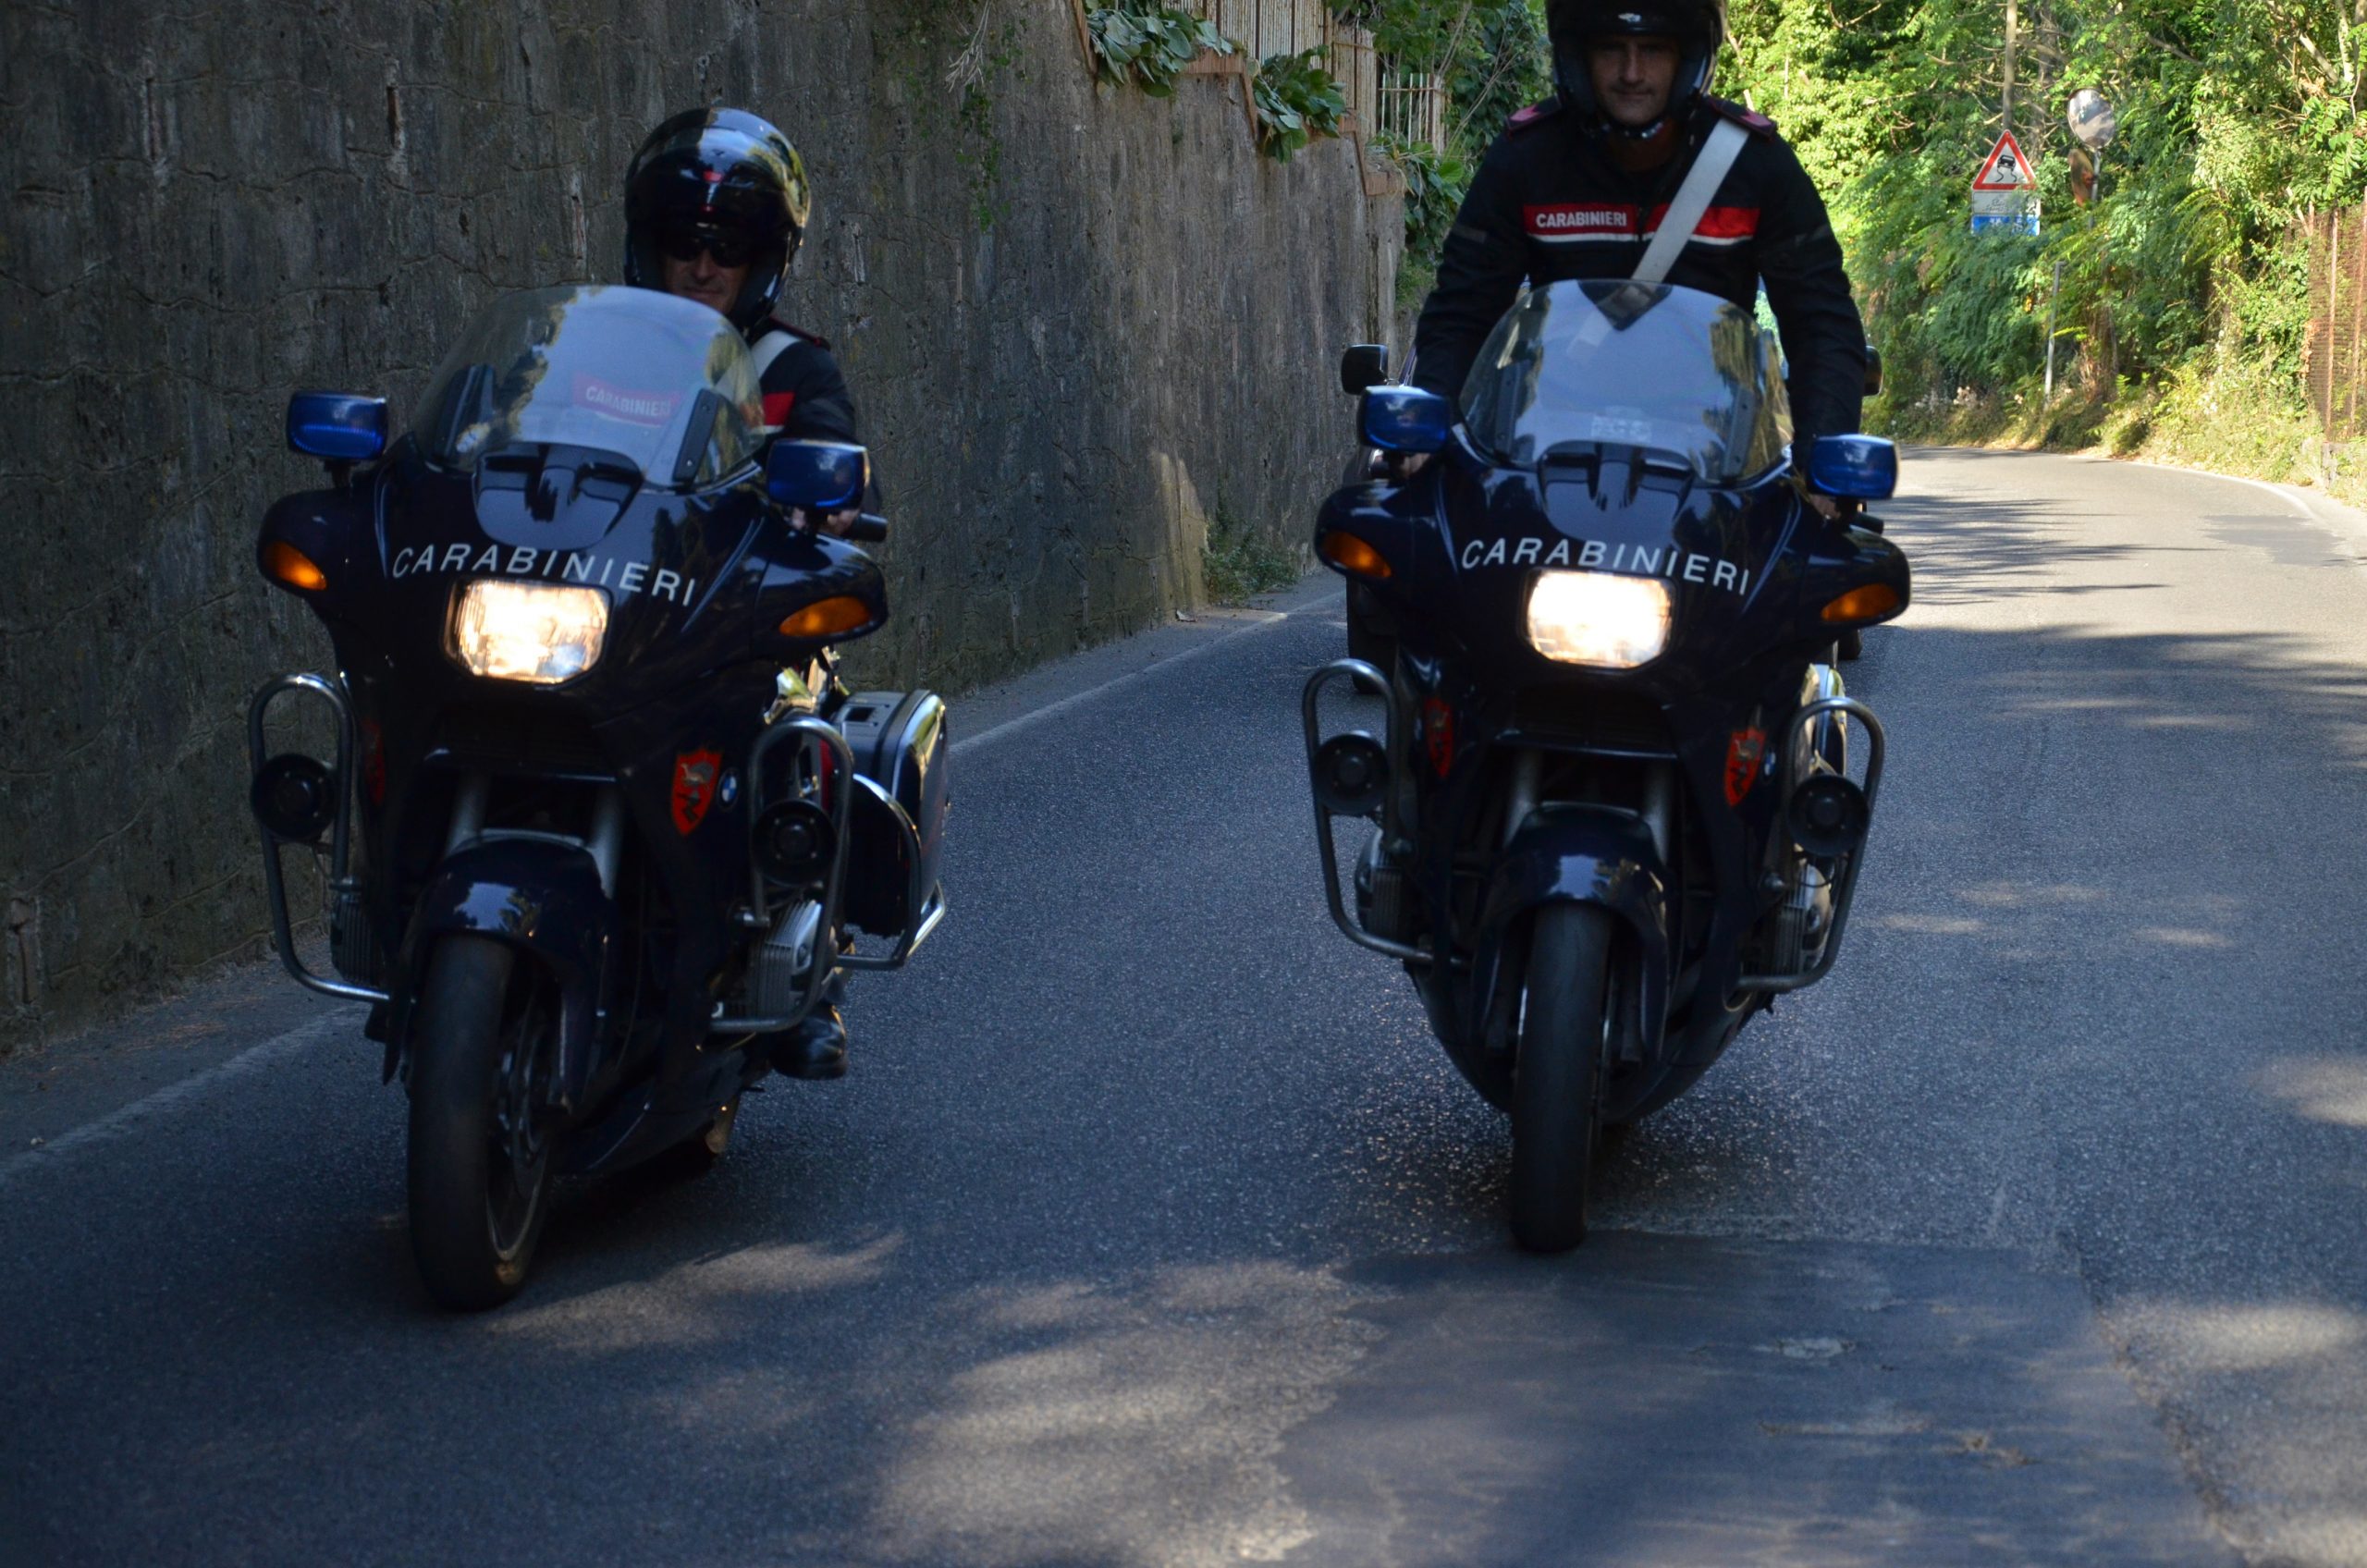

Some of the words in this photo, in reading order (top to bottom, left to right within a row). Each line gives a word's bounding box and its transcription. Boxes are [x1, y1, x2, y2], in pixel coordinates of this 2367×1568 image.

[1536, 211, 1627, 227] CARABINIERI
[392, 544, 695, 606] CARABINIERI
[1461, 537, 1749, 595] CARABINIERI
